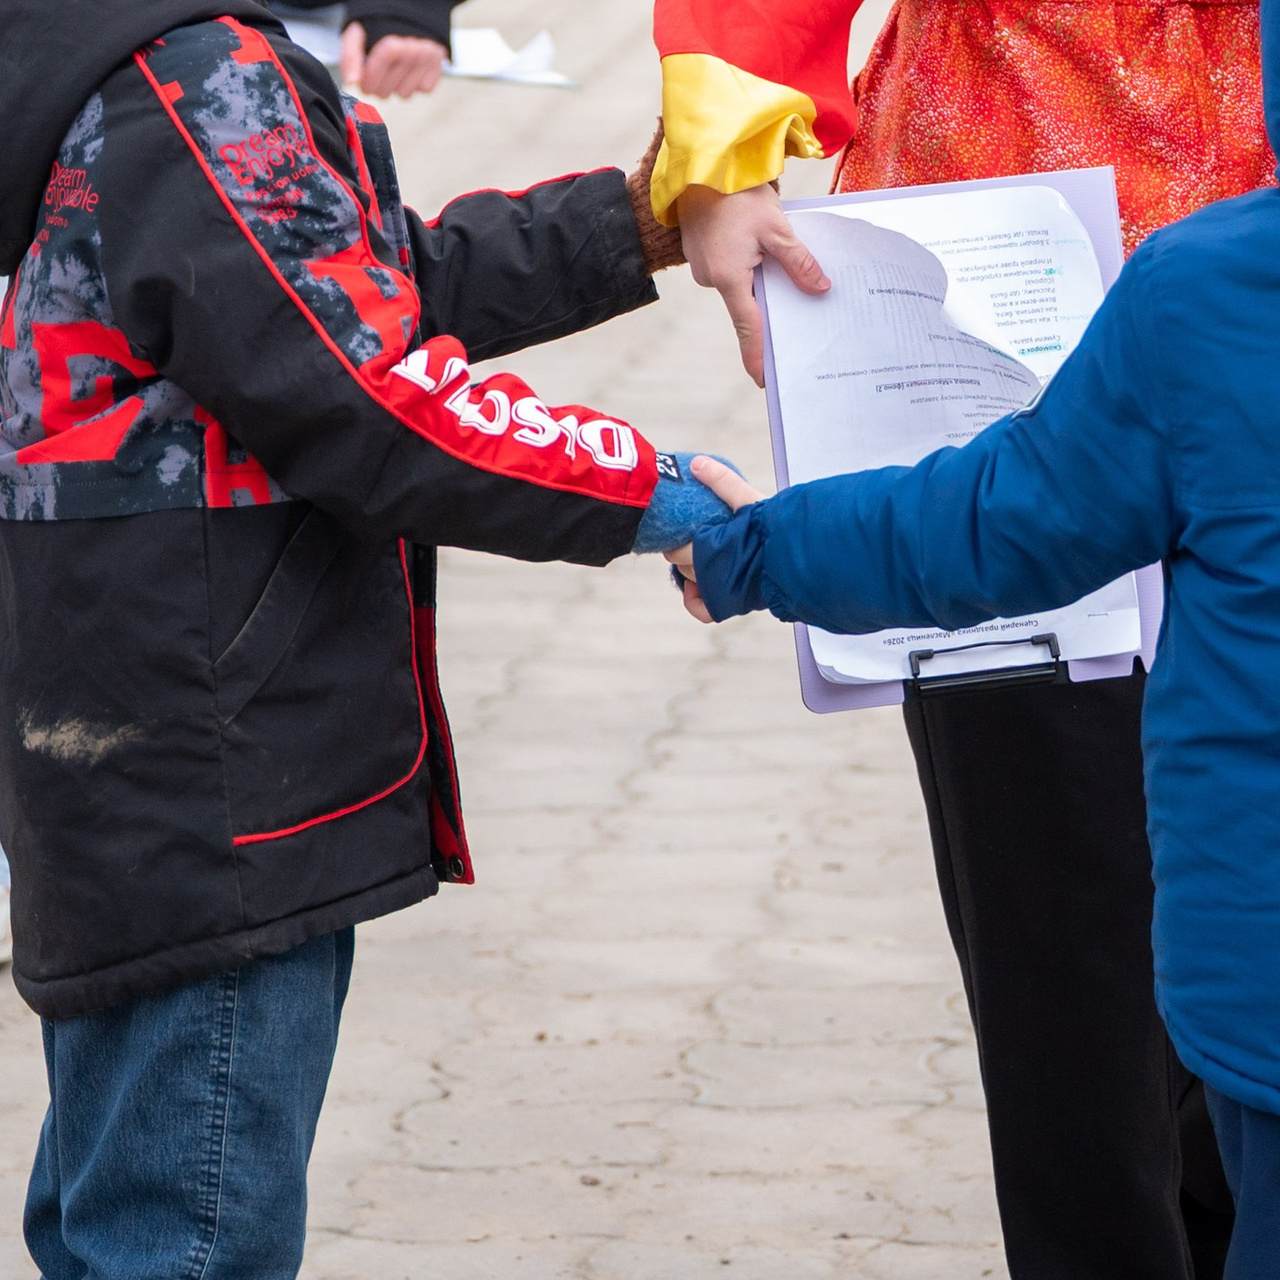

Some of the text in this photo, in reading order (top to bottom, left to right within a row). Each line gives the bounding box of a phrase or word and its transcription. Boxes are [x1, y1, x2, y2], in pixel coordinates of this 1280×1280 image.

[217, 123, 300, 165] Dream
[49, 160, 87, 188] Dream
[1027, 344, 1062, 354] Скоморох
[882, 620, 1039, 646] Сценарий праздника «Масленица 2026»
